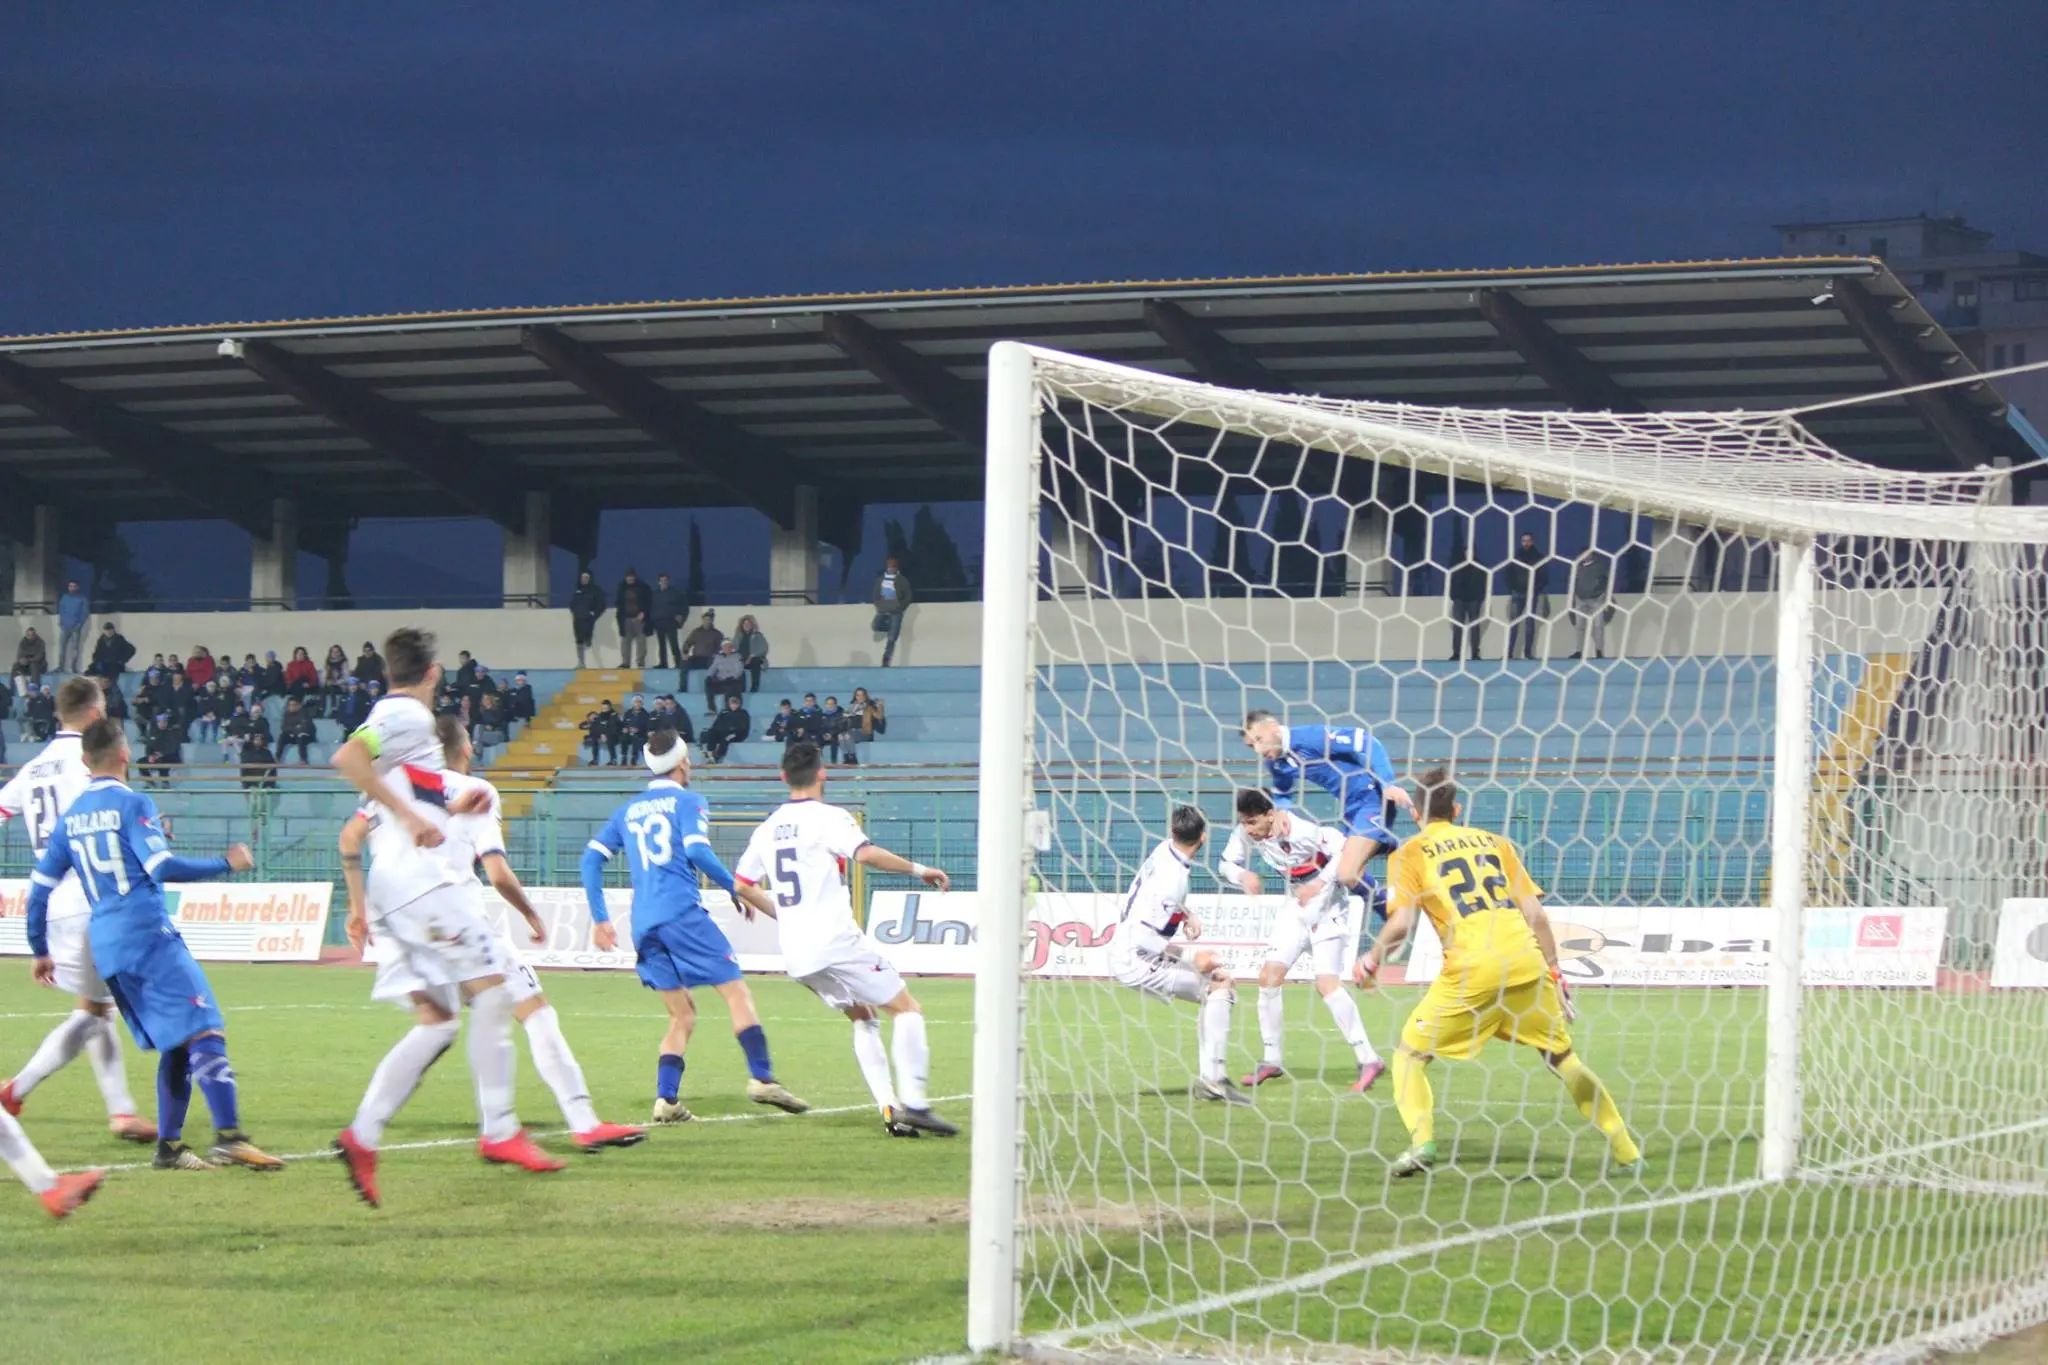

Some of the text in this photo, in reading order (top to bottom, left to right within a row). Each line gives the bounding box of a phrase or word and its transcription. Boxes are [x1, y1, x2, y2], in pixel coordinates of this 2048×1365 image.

[69, 831, 130, 902] 14
[627, 814, 673, 871] 13
[776, 848, 802, 907] 5
[1440, 854, 1516, 918] 22
[257, 928, 304, 952] cash
